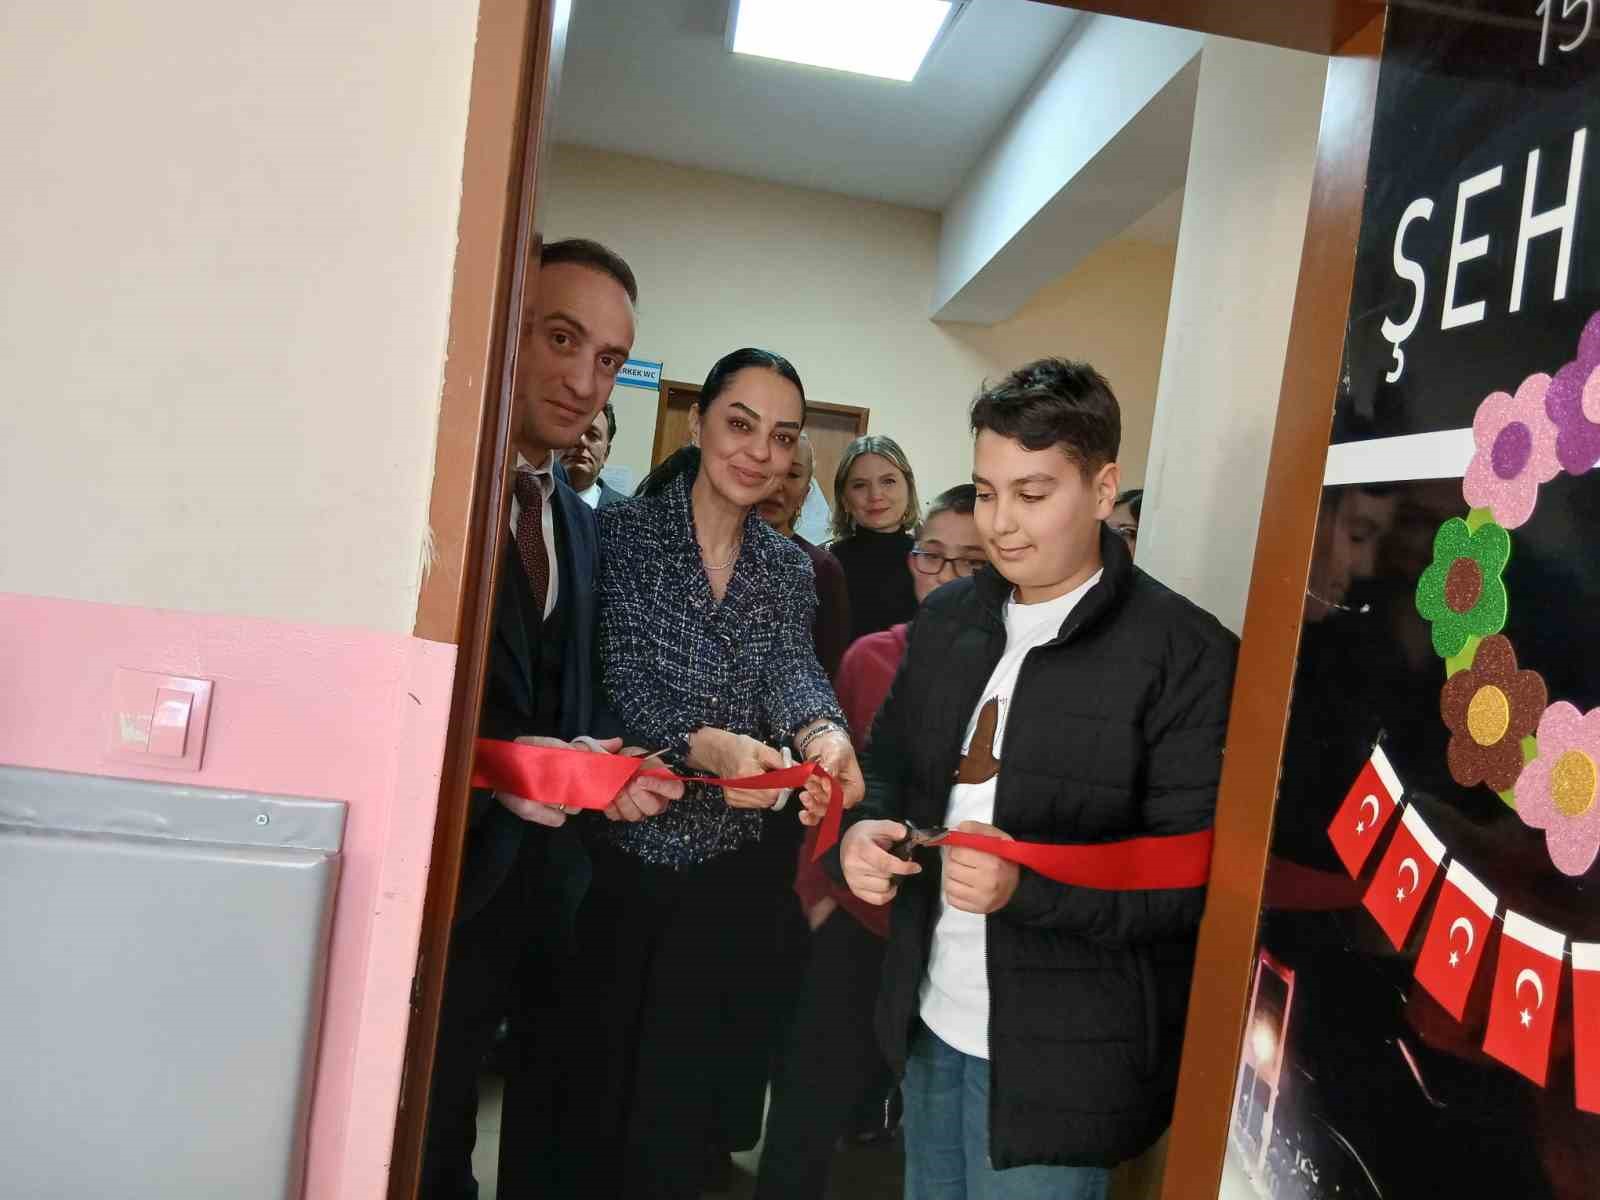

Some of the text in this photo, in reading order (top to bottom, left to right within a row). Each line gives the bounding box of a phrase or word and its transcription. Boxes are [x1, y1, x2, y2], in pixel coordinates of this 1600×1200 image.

[1381, 127, 1588, 384] ŞEH
[618, 367, 657, 379] RKEK WC
